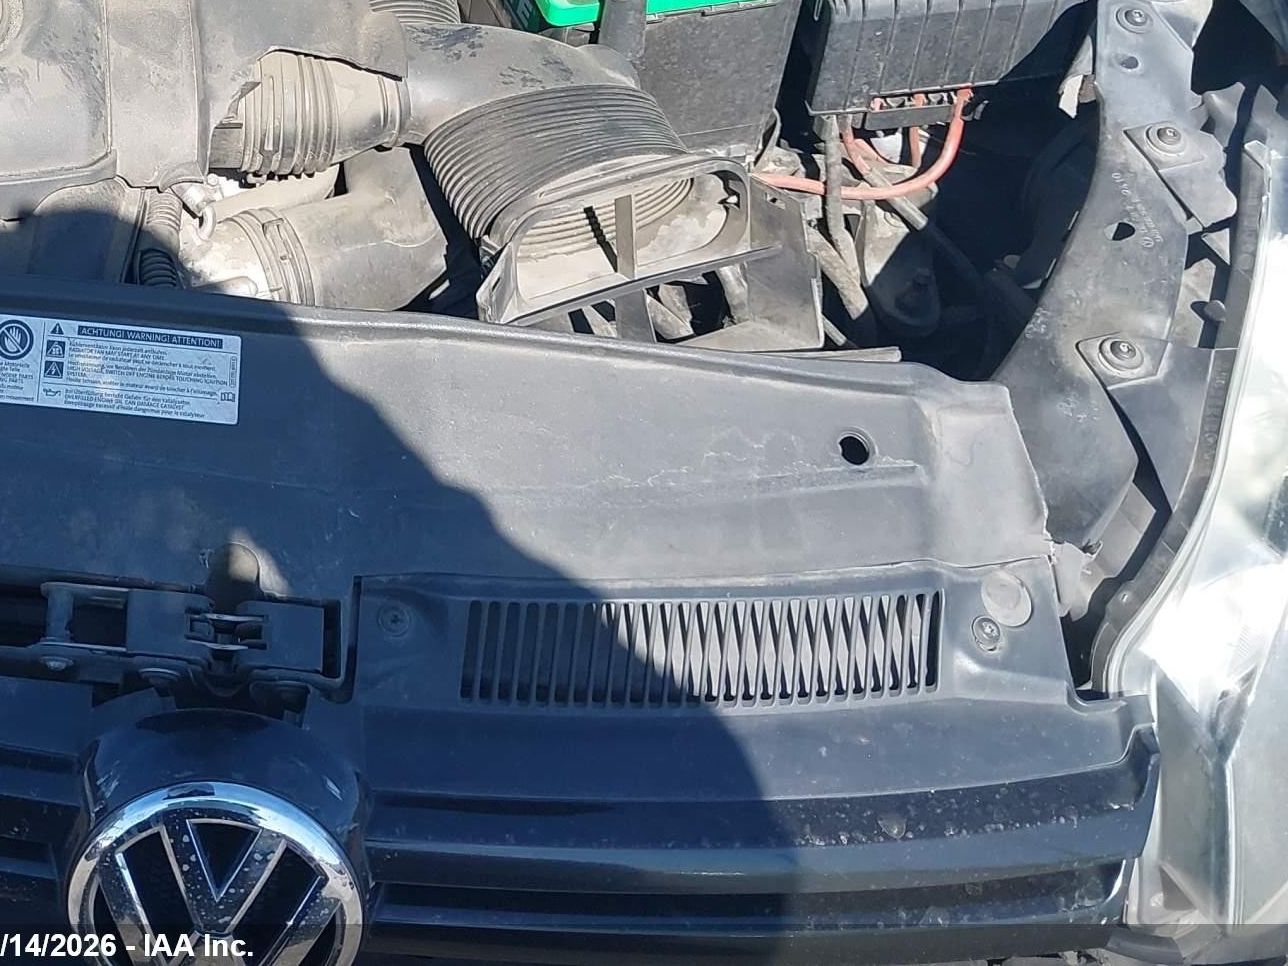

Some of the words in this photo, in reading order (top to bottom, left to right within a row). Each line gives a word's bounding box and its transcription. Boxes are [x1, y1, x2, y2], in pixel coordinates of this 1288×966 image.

[81, 326, 124, 338] ACHTUNG!
[126, 331, 169, 342] WARNING!
[171, 335, 219, 347] ATTENTION!
